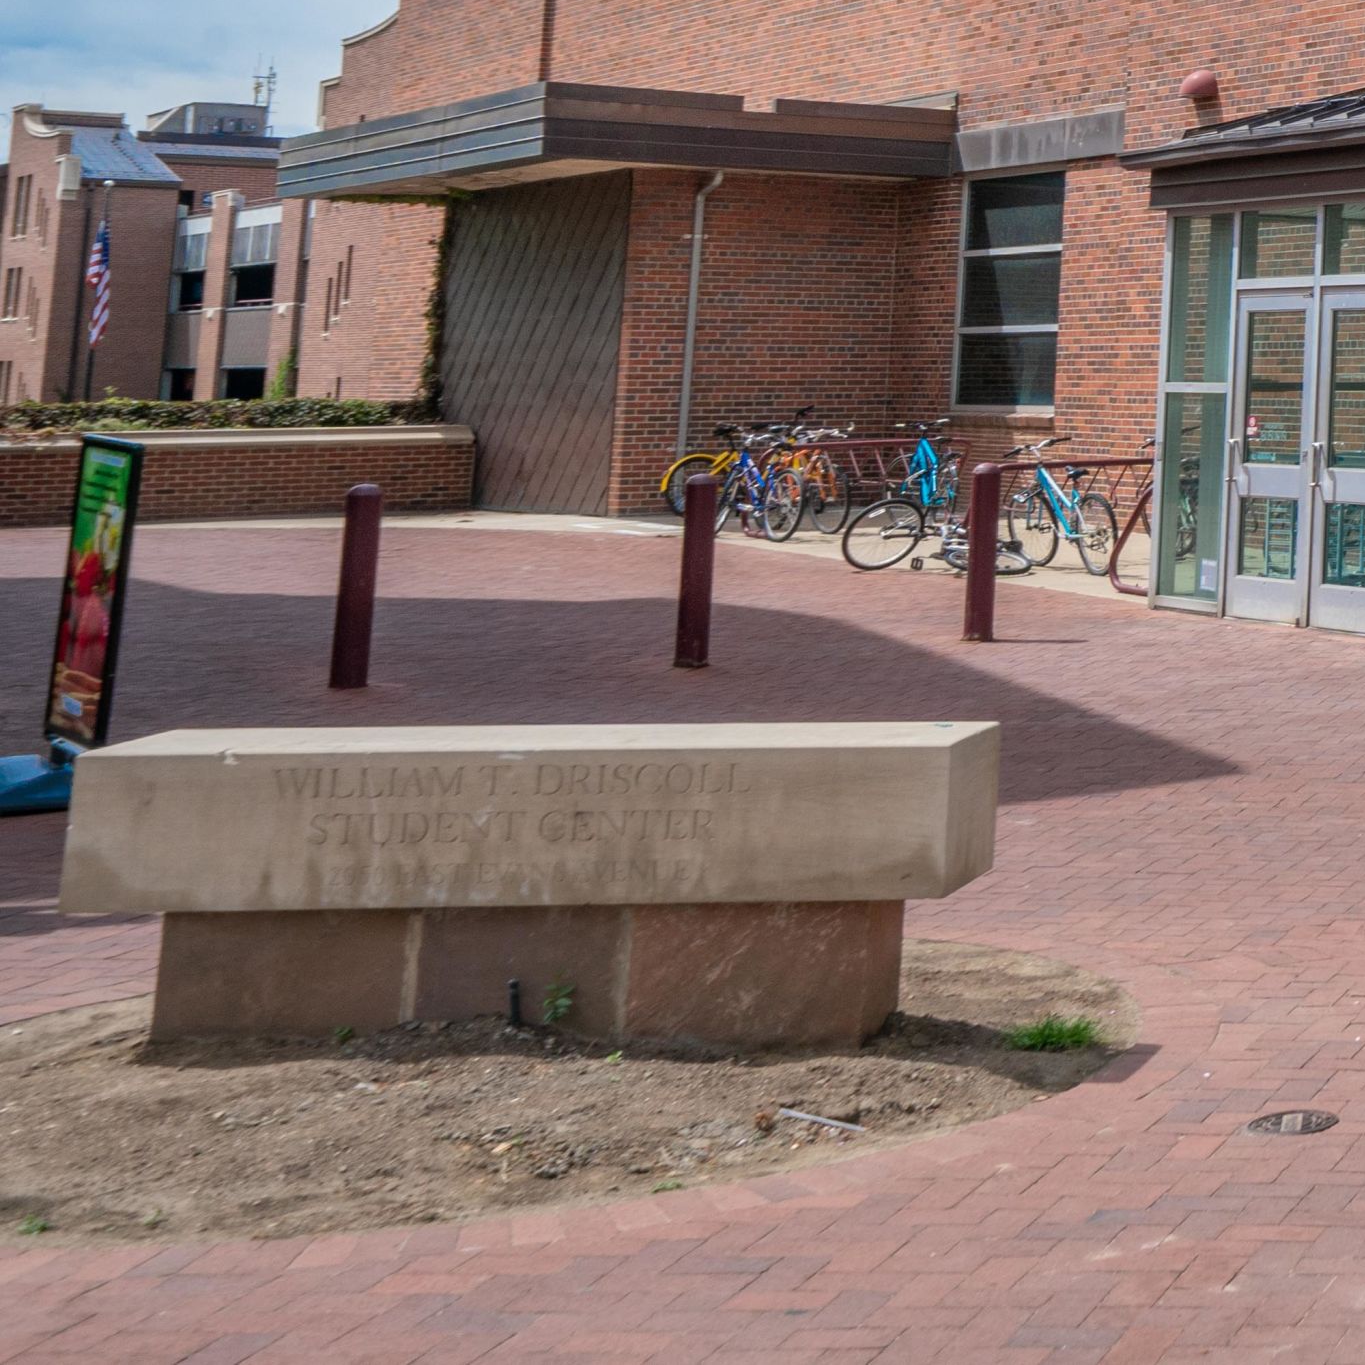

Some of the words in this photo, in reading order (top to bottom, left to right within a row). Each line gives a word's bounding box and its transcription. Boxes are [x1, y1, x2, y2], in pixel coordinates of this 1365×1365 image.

[272, 765, 467, 800] WILLIAM
[478, 764, 518, 797] T.
[534, 762, 751, 795] DRISCOLL
[306, 811, 528, 848] STUDENT
[538, 810, 715, 843] CENTER
